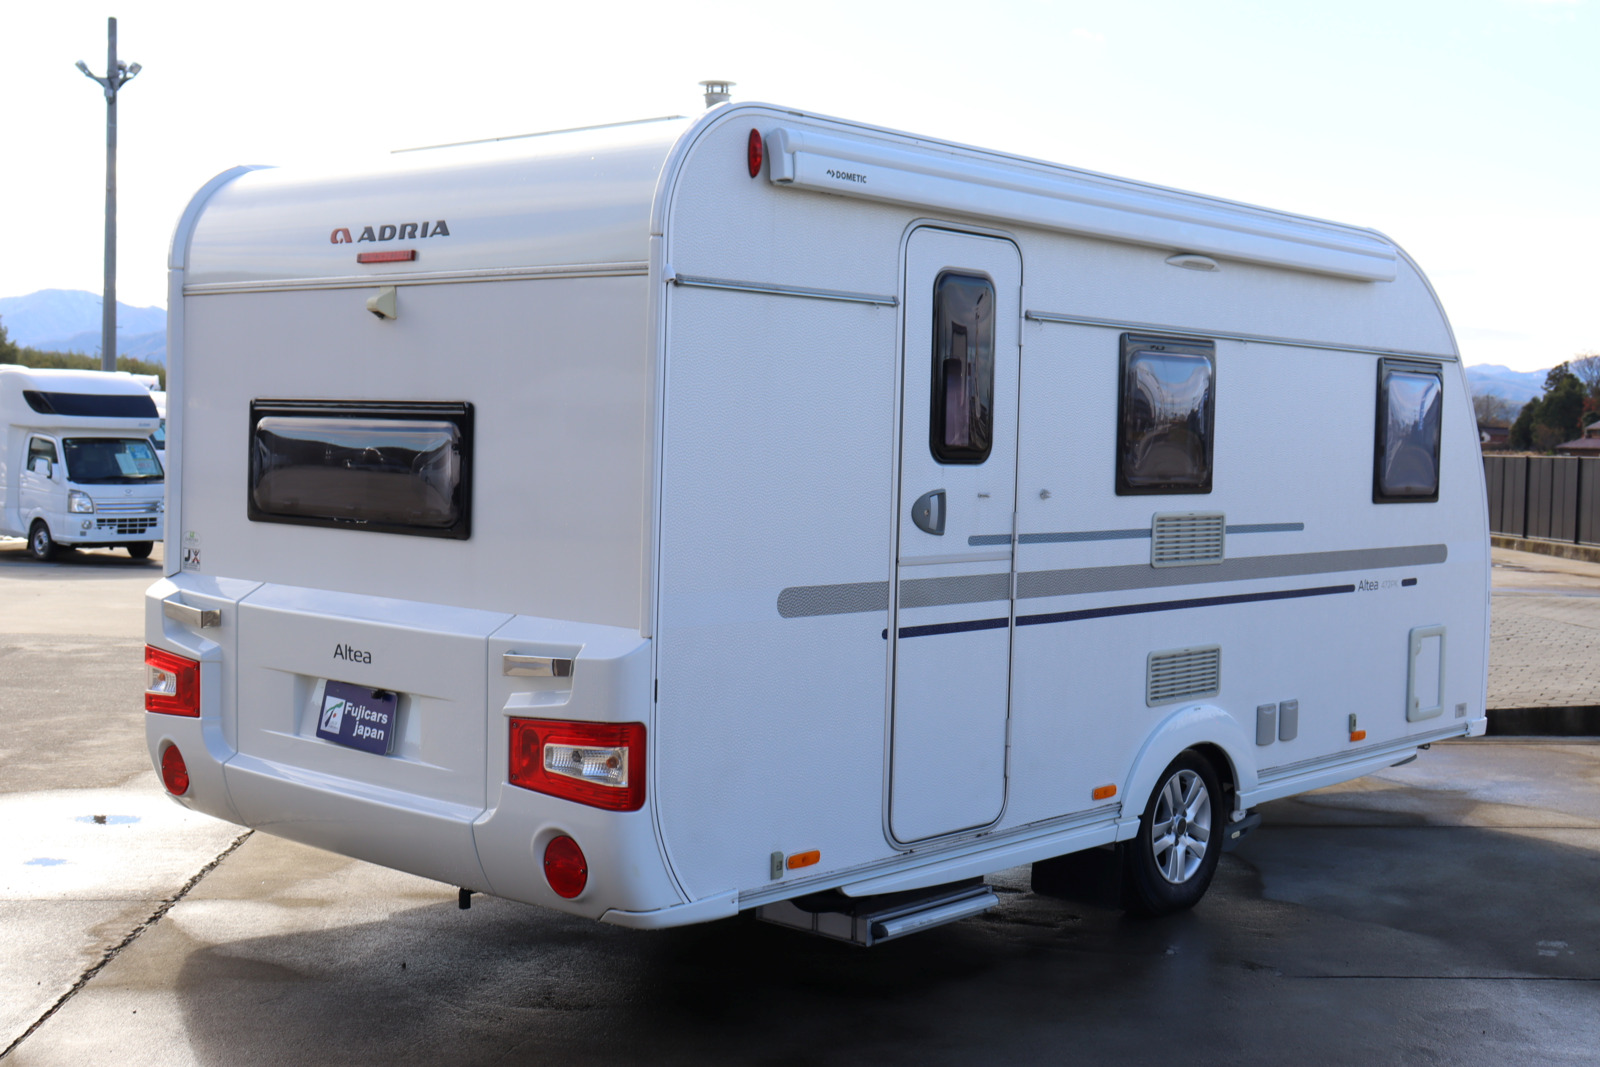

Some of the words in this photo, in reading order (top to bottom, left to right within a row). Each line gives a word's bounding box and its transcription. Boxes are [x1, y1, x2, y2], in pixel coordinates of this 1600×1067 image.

[836, 170, 867, 184] DOMETIC
[357, 220, 450, 243] ADRIA
[1358, 579, 1379, 592] Altea
[333, 643, 372, 665] Altea
[344, 701, 388, 725] Fujicars
[352, 720, 385, 741] japan
